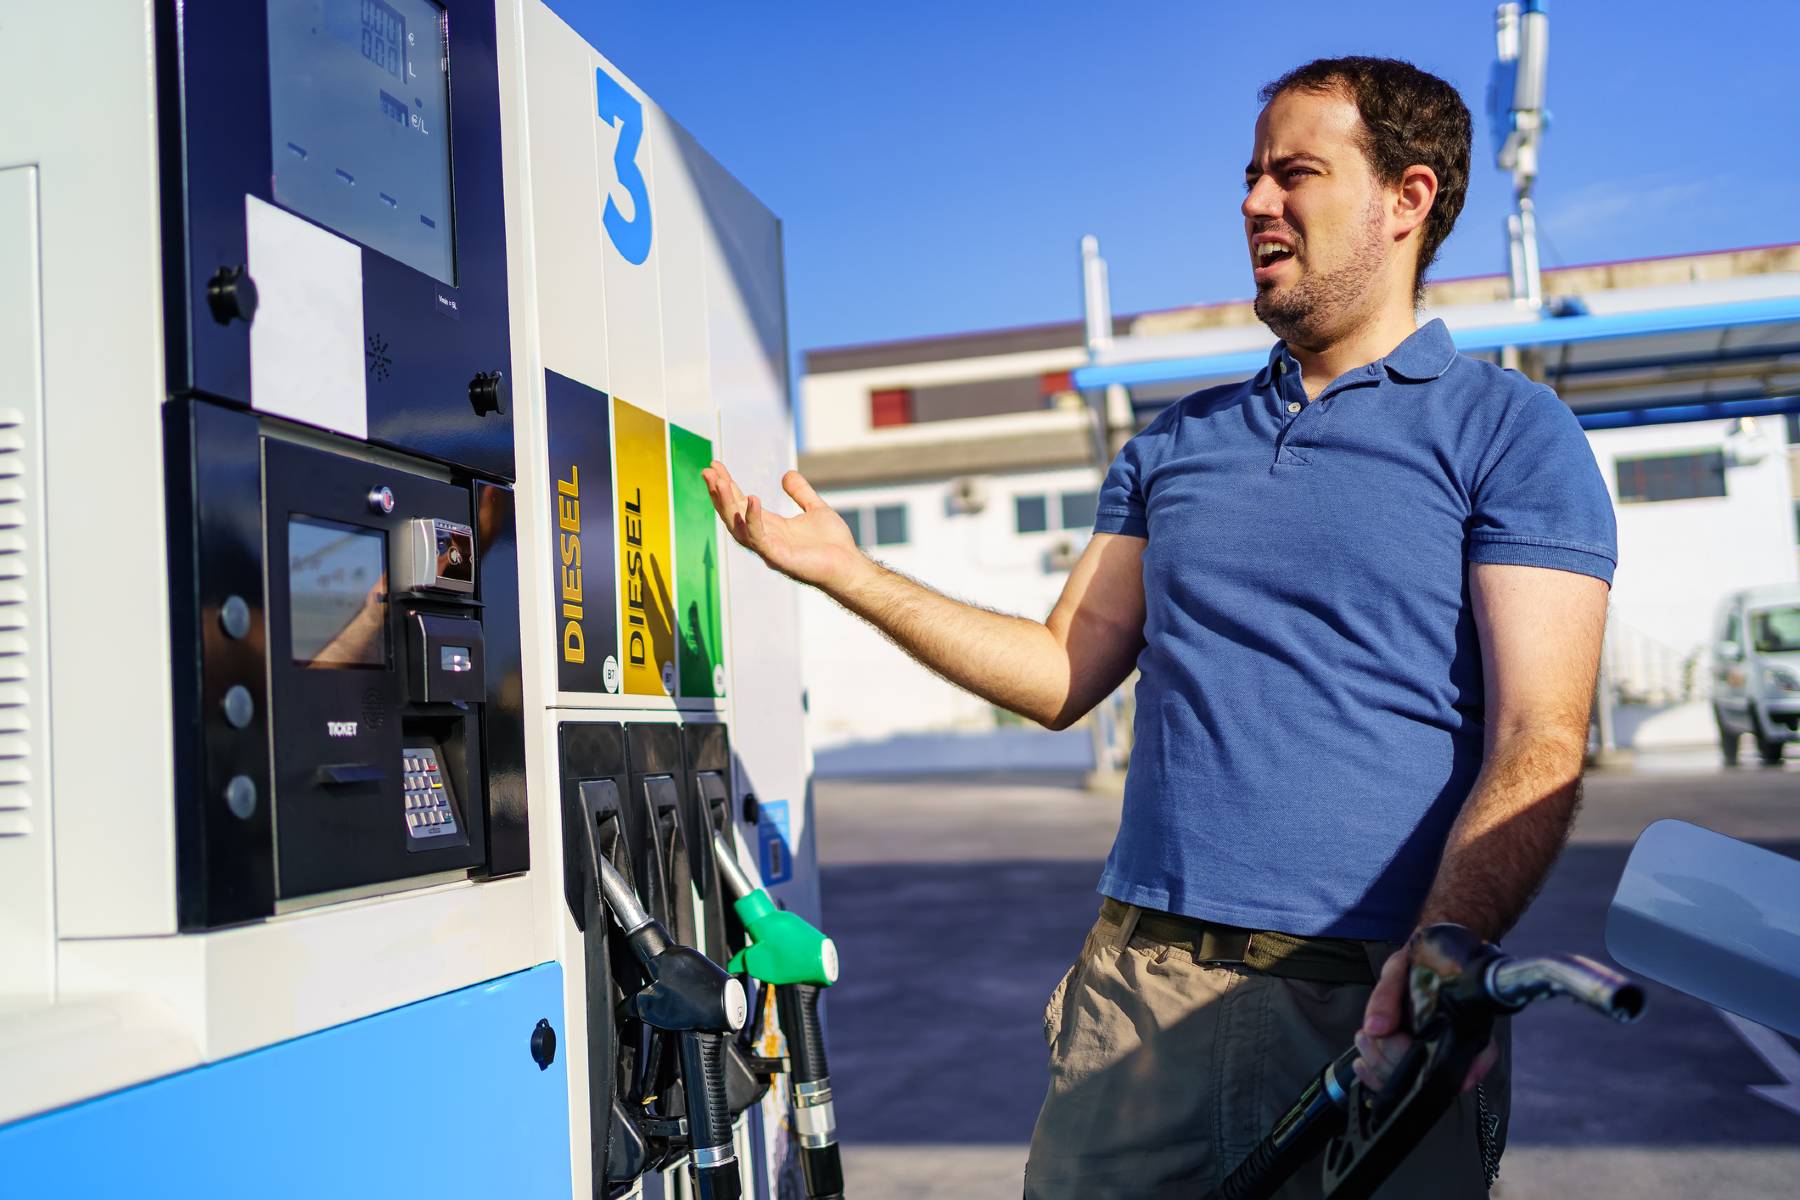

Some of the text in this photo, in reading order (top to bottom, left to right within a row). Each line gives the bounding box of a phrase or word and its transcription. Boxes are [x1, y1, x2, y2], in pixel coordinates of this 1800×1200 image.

[408, 61, 417, 78] L
[596, 67, 653, 265] 3
[558, 464, 585, 664] DIESEL
[625, 487, 646, 666] DIESEL
[327, 721, 358, 736] TICKET
